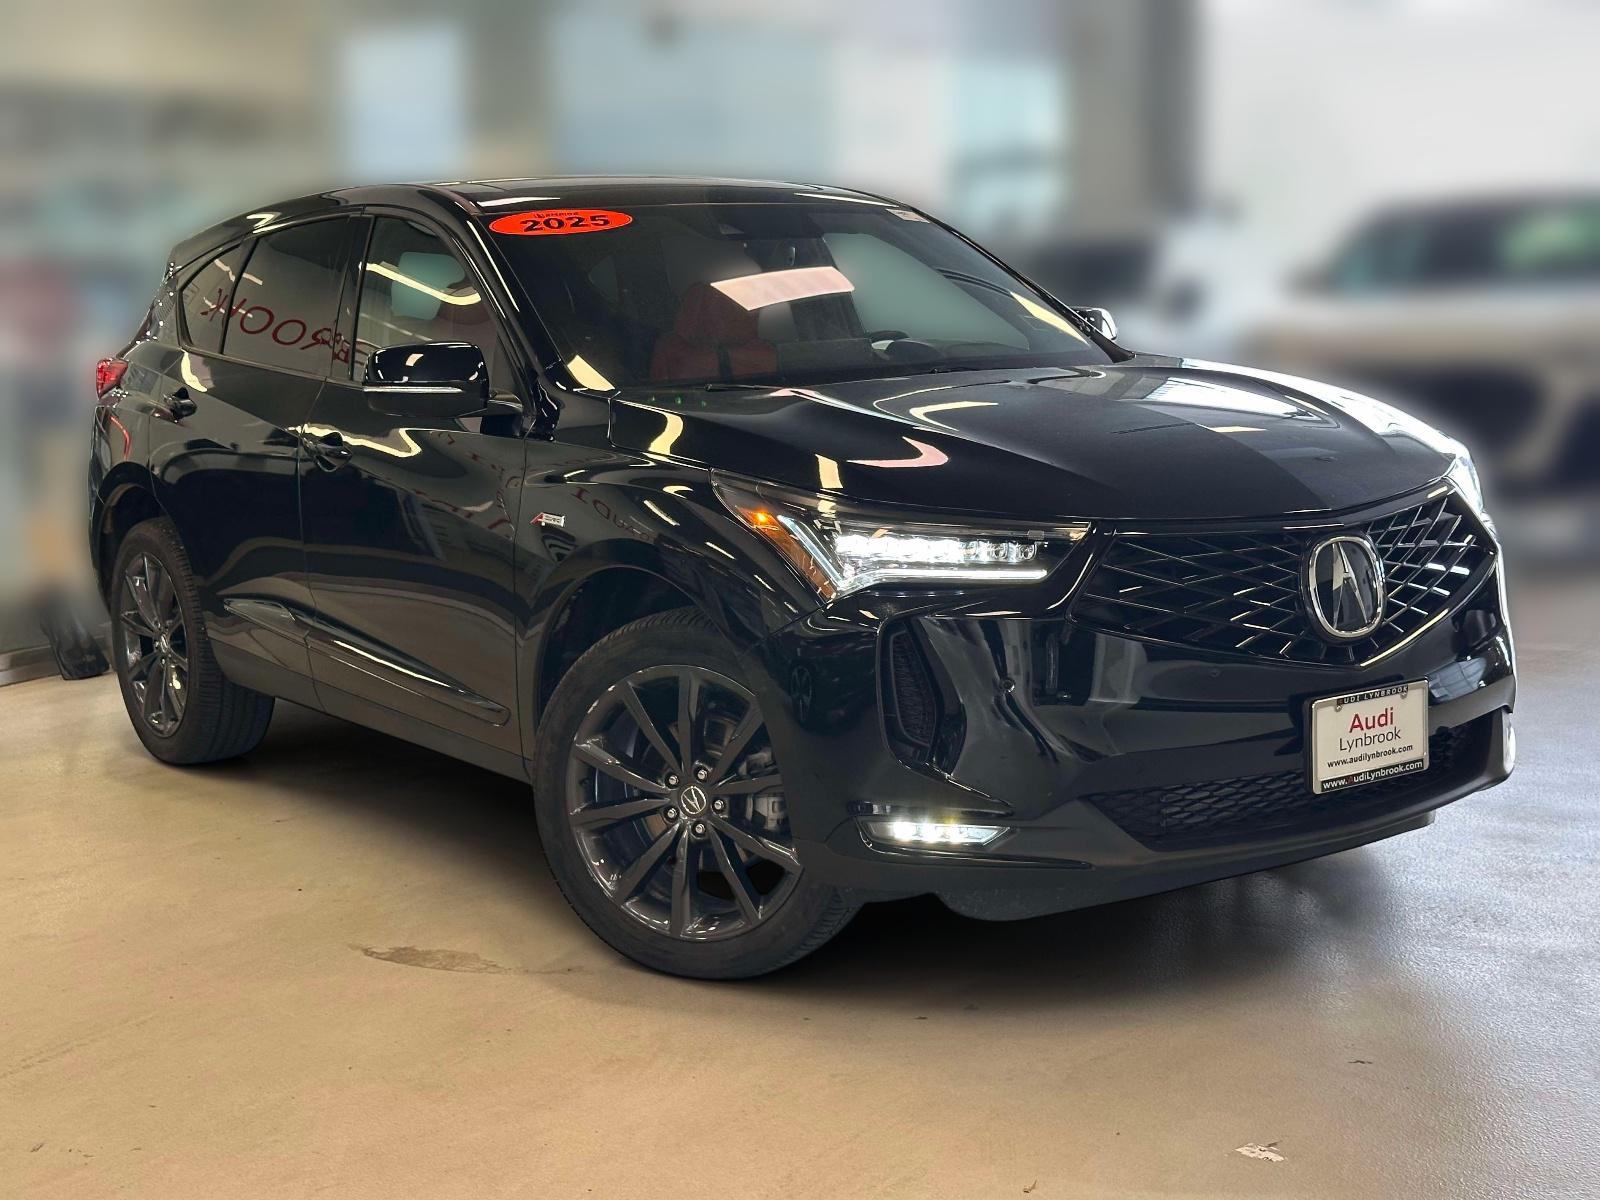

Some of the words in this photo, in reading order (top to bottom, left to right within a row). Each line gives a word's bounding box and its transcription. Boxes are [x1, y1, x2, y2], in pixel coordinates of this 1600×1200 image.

[520, 215, 610, 232] 2025
[1364, 686, 1408, 700] LYNBROOK
[1349, 707, 1394, 733] Audi
[1339, 726, 1401, 752] Lynbrook
[1327, 745, 1413, 768] www.audilynbrook.com
